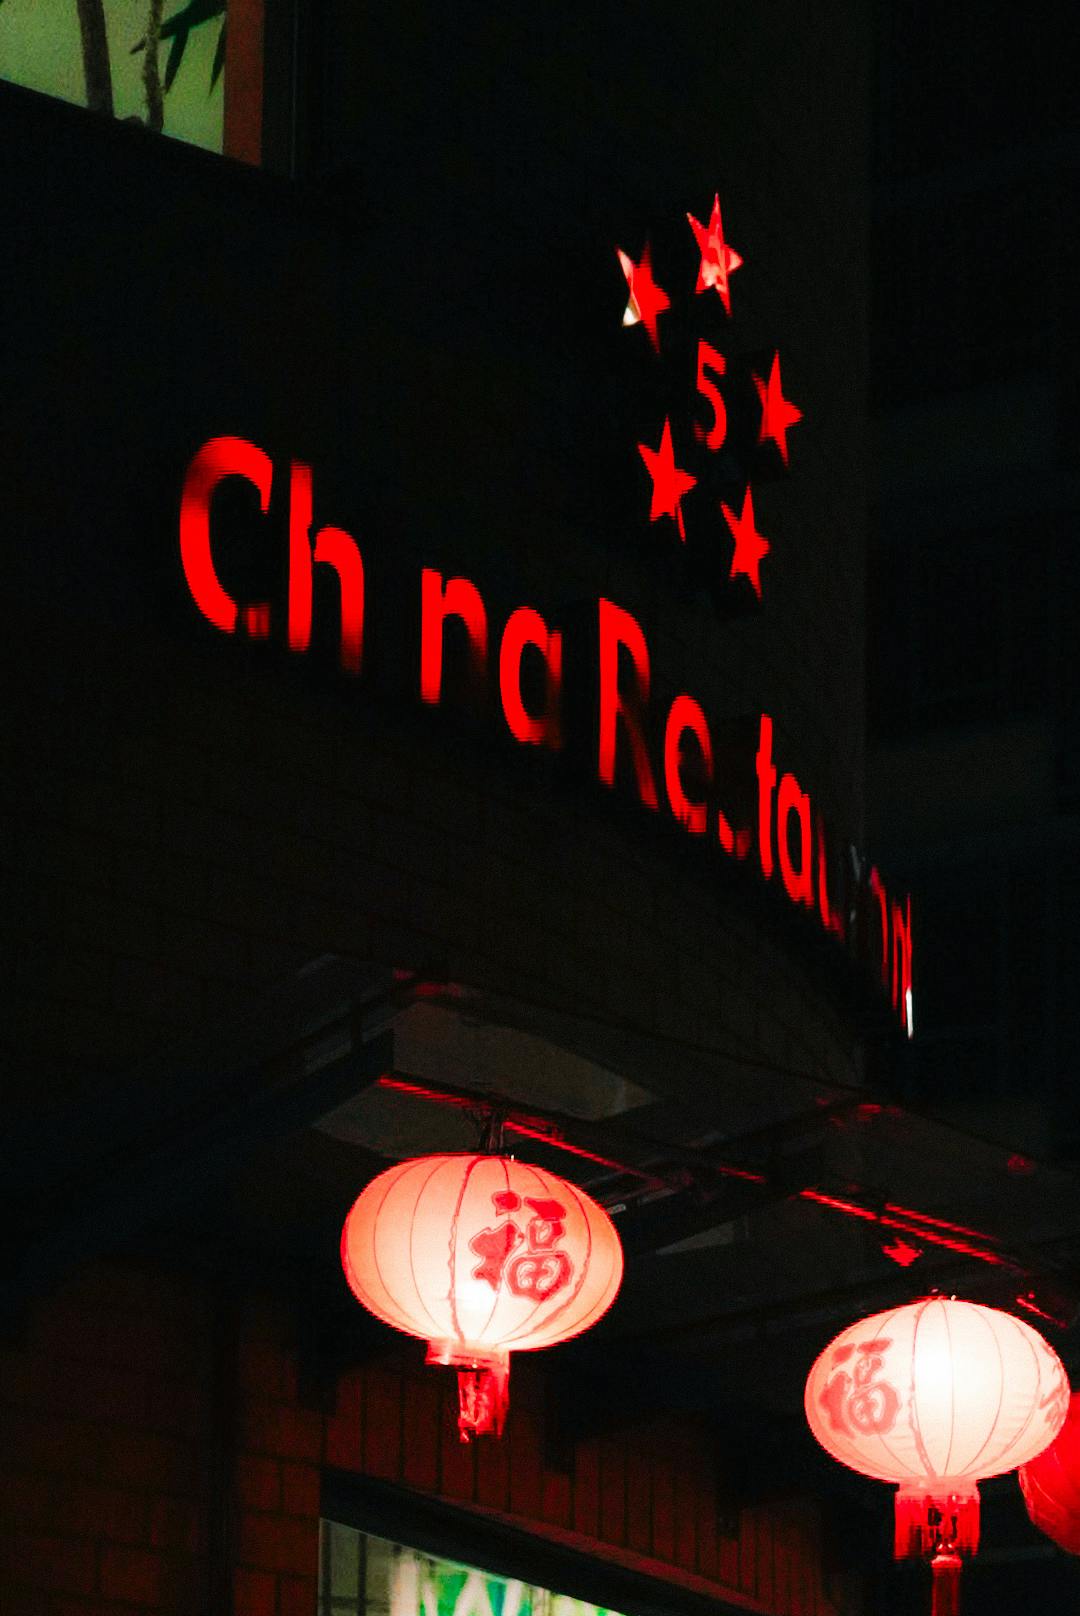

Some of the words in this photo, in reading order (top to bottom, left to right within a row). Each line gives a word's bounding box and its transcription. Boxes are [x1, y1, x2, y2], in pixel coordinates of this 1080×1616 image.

[694, 338, 727, 452] 5
[179, 435, 563, 746] Chna
[468, 1189, 574, 1304] 福
[819, 1338, 901, 1439] 福
